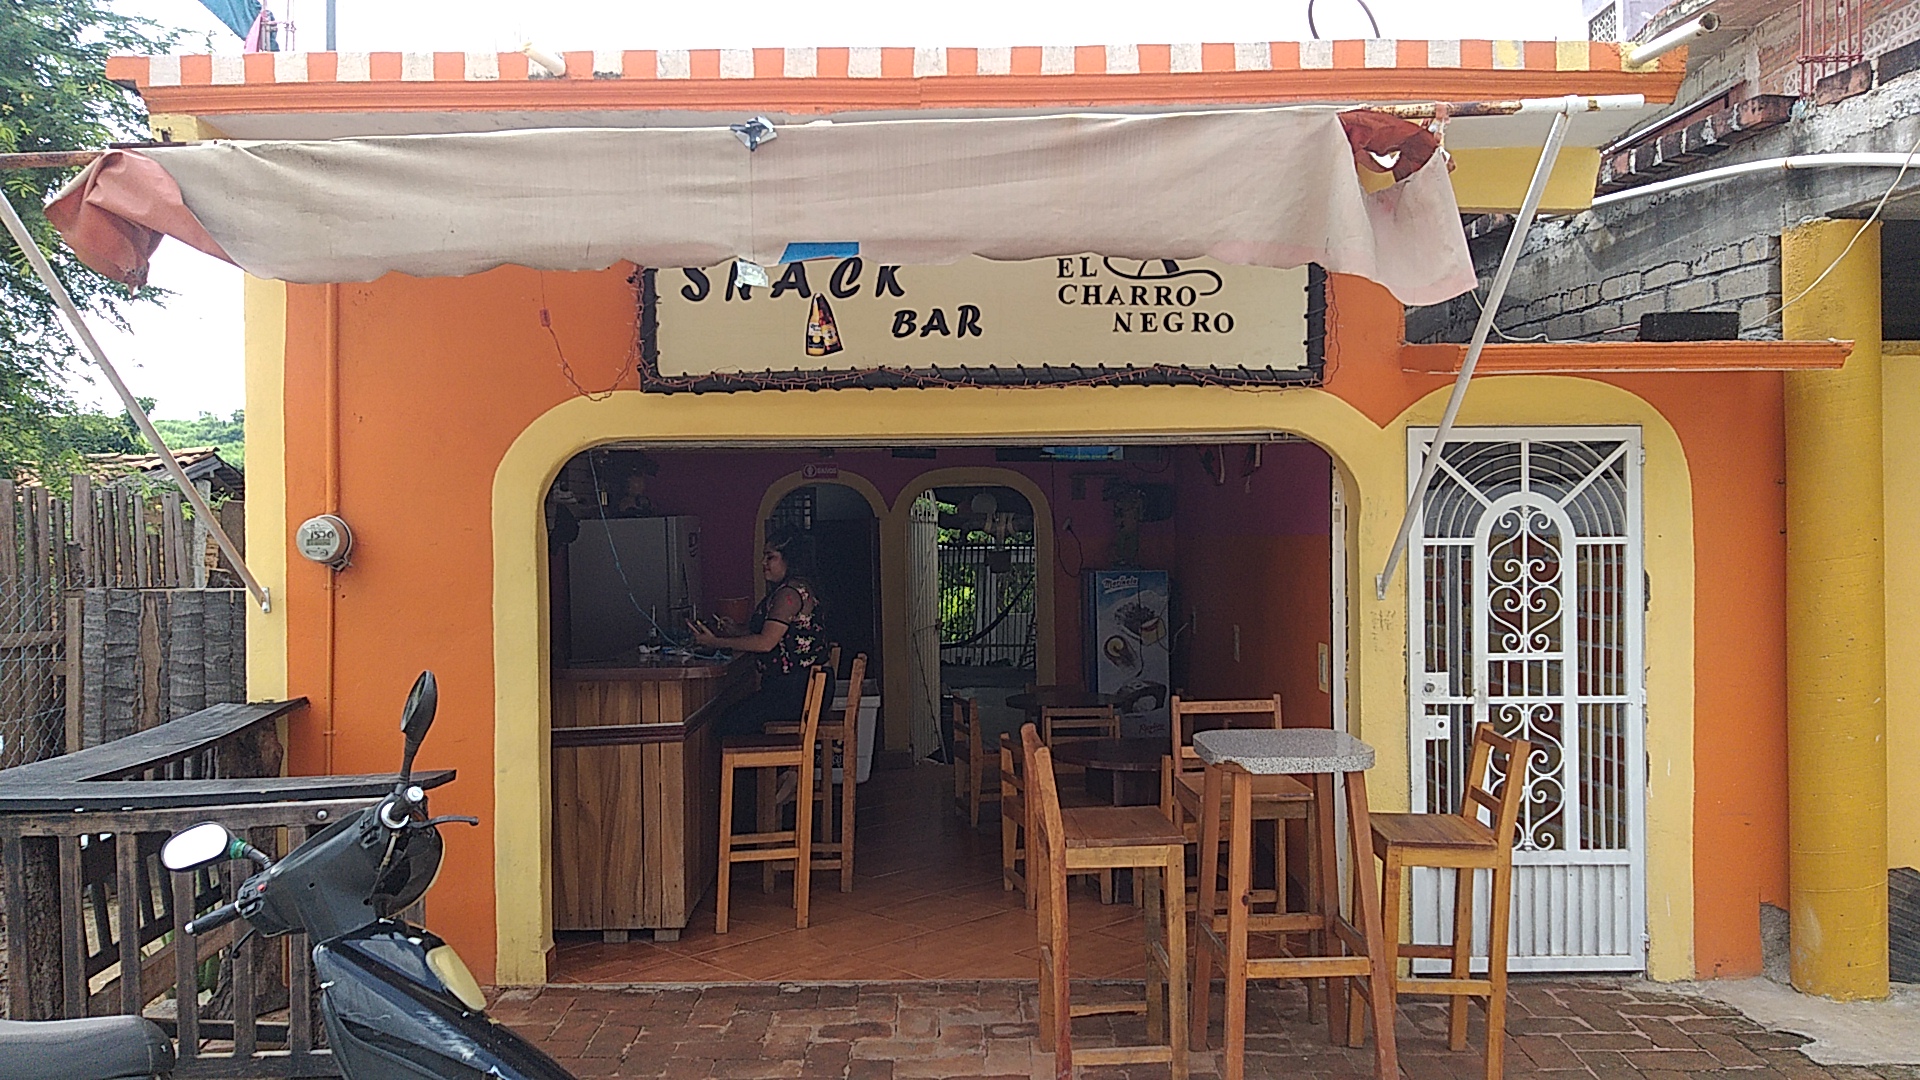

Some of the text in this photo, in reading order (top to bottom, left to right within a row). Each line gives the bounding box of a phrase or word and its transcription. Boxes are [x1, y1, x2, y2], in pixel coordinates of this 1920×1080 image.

[1057, 256, 1098, 279] EL
[1058, 284, 1197, 307] CHARRO
[892, 305, 982, 338] BAR
[1113, 312, 1235, 334] NEGRO
